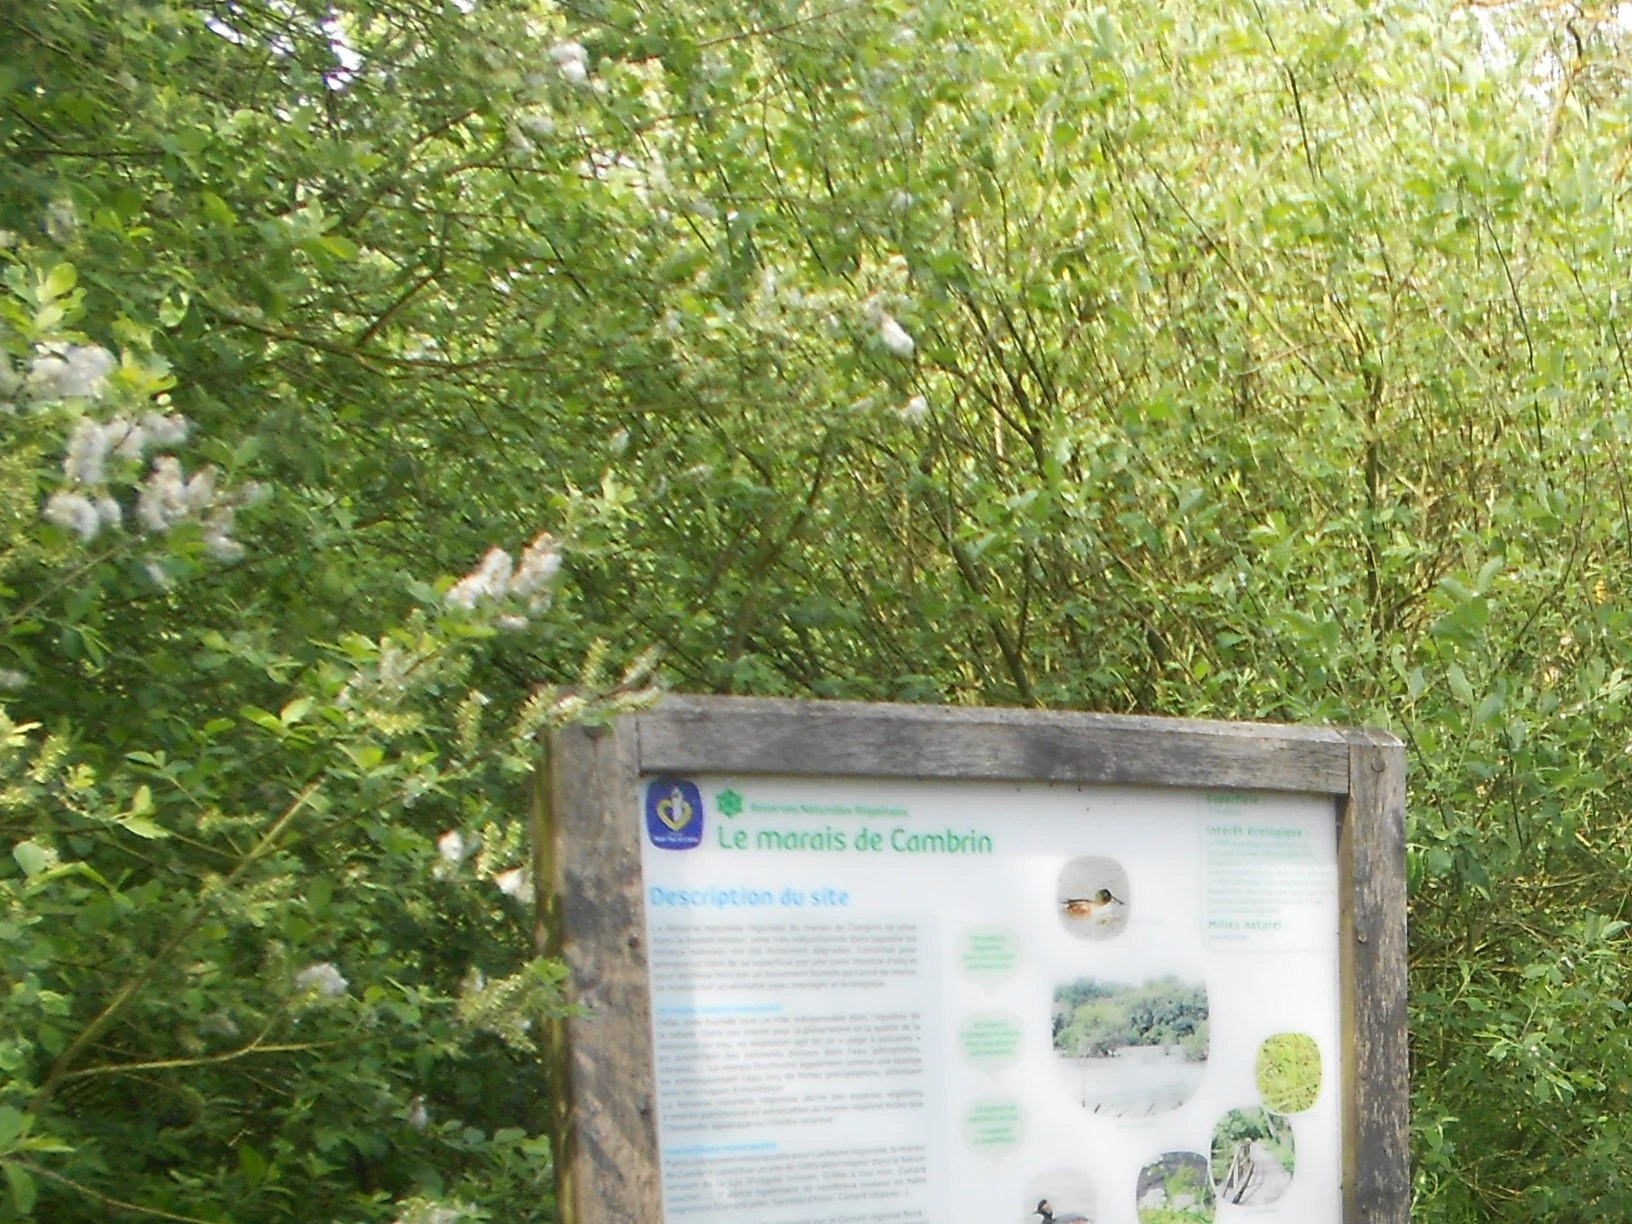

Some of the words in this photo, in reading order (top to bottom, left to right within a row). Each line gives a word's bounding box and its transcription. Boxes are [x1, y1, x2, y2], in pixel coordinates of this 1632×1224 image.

[717, 825, 748, 850] Le
[756, 825, 847, 851] marais
[854, 827, 884, 852] de
[890, 829, 993, 854] Cambrin
[1246, 825, 1303, 839] écologique
[649, 886, 772, 909] Description
[780, 886, 805, 907] du
[811, 886, 850, 907] site
[1208, 919, 1240, 931] Milieu
[1244, 919, 1283, 931] naturel
